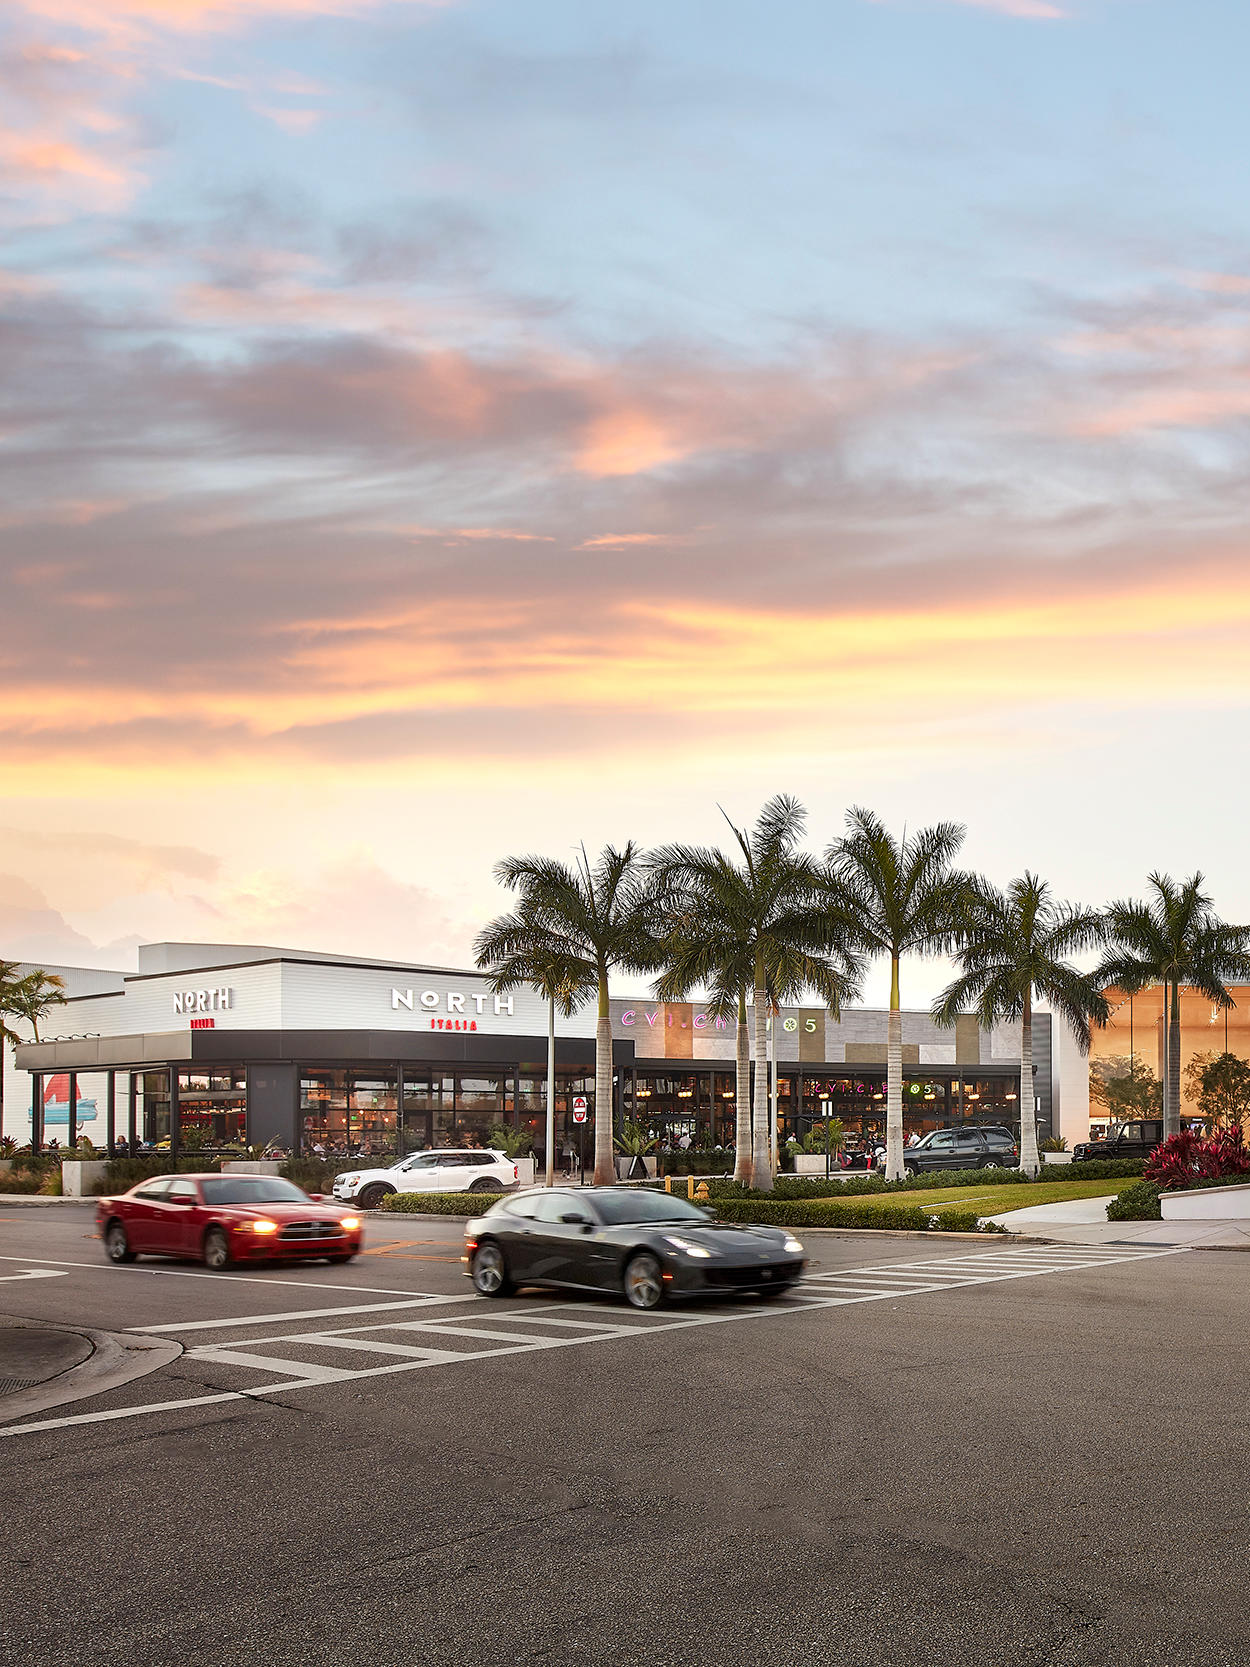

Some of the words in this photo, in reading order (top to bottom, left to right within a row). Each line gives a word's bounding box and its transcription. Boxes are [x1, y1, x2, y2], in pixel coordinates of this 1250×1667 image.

[172, 986, 233, 1014] NORTH
[391, 988, 514, 1016] NORTH
[431, 1018, 477, 1031] ITALIA
[621, 1009, 739, 1031] CVI.CH
